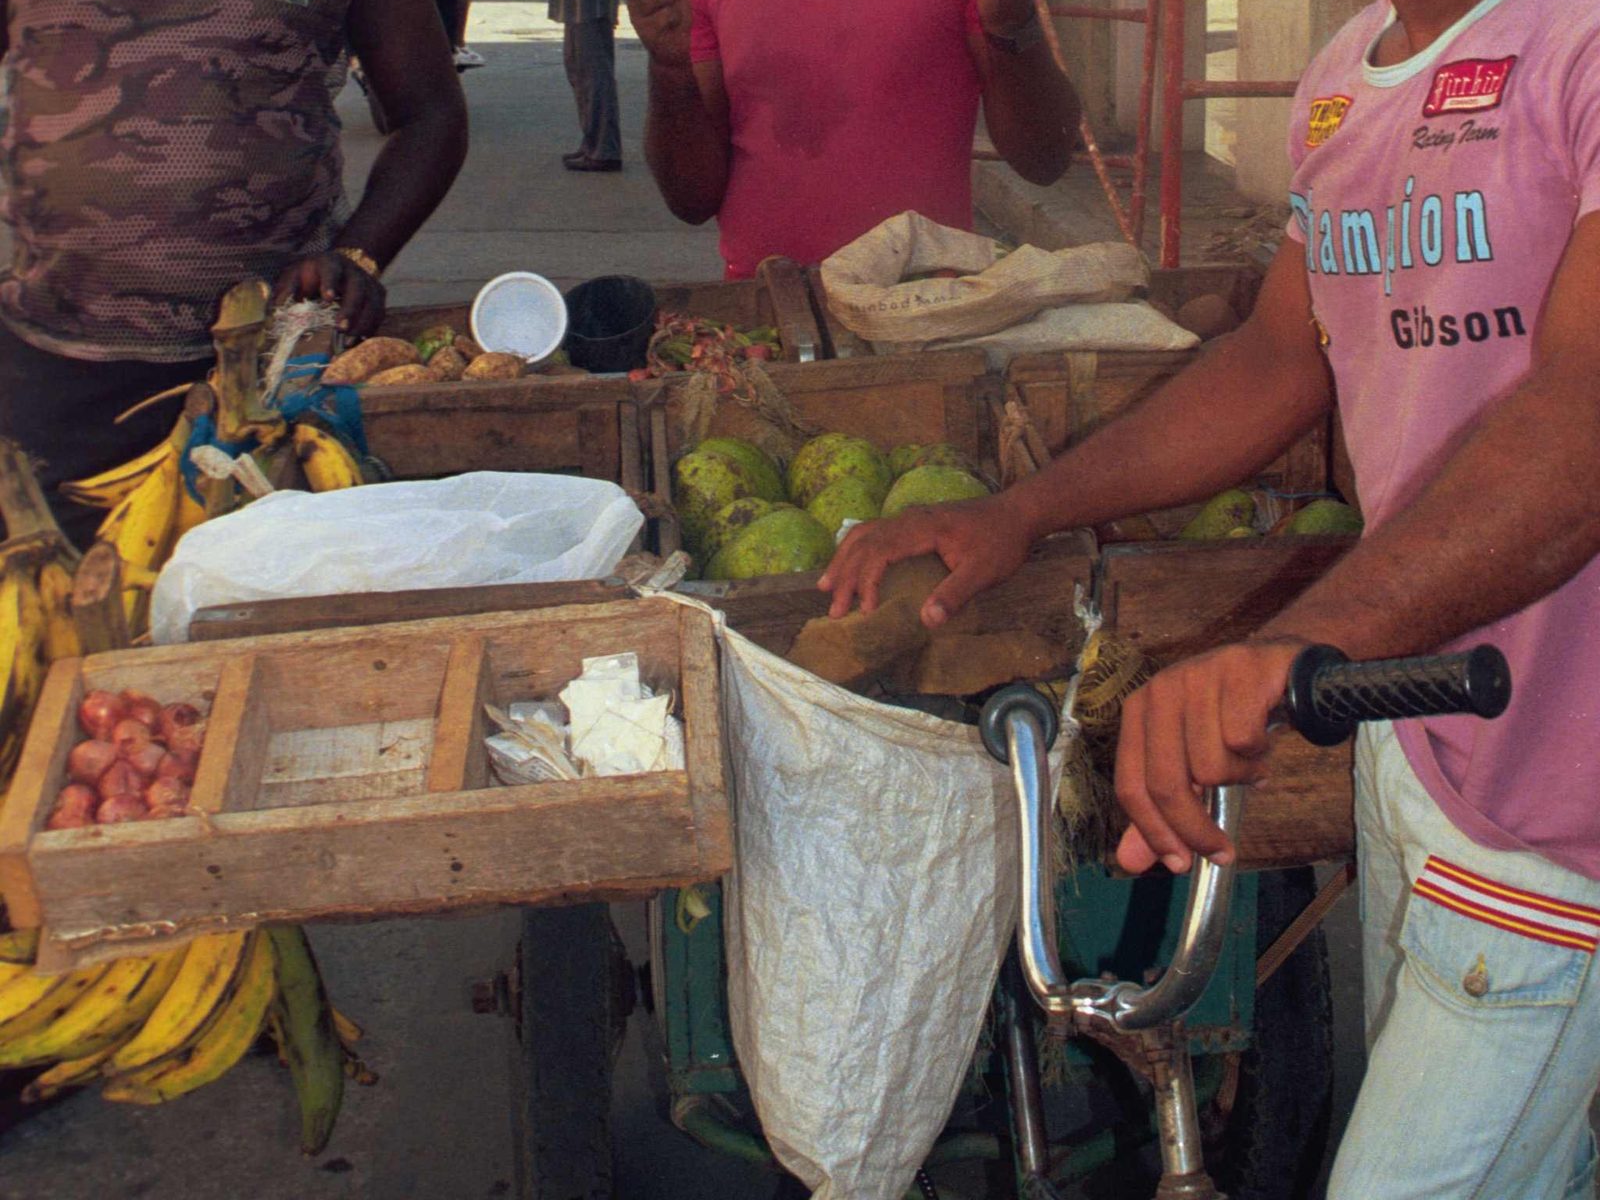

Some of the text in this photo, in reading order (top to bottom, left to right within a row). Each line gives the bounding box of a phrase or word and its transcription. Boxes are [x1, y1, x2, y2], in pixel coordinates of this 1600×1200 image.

[1413, 119, 1499, 153] Racing Team
[1390, 305, 1526, 349] Gibson
